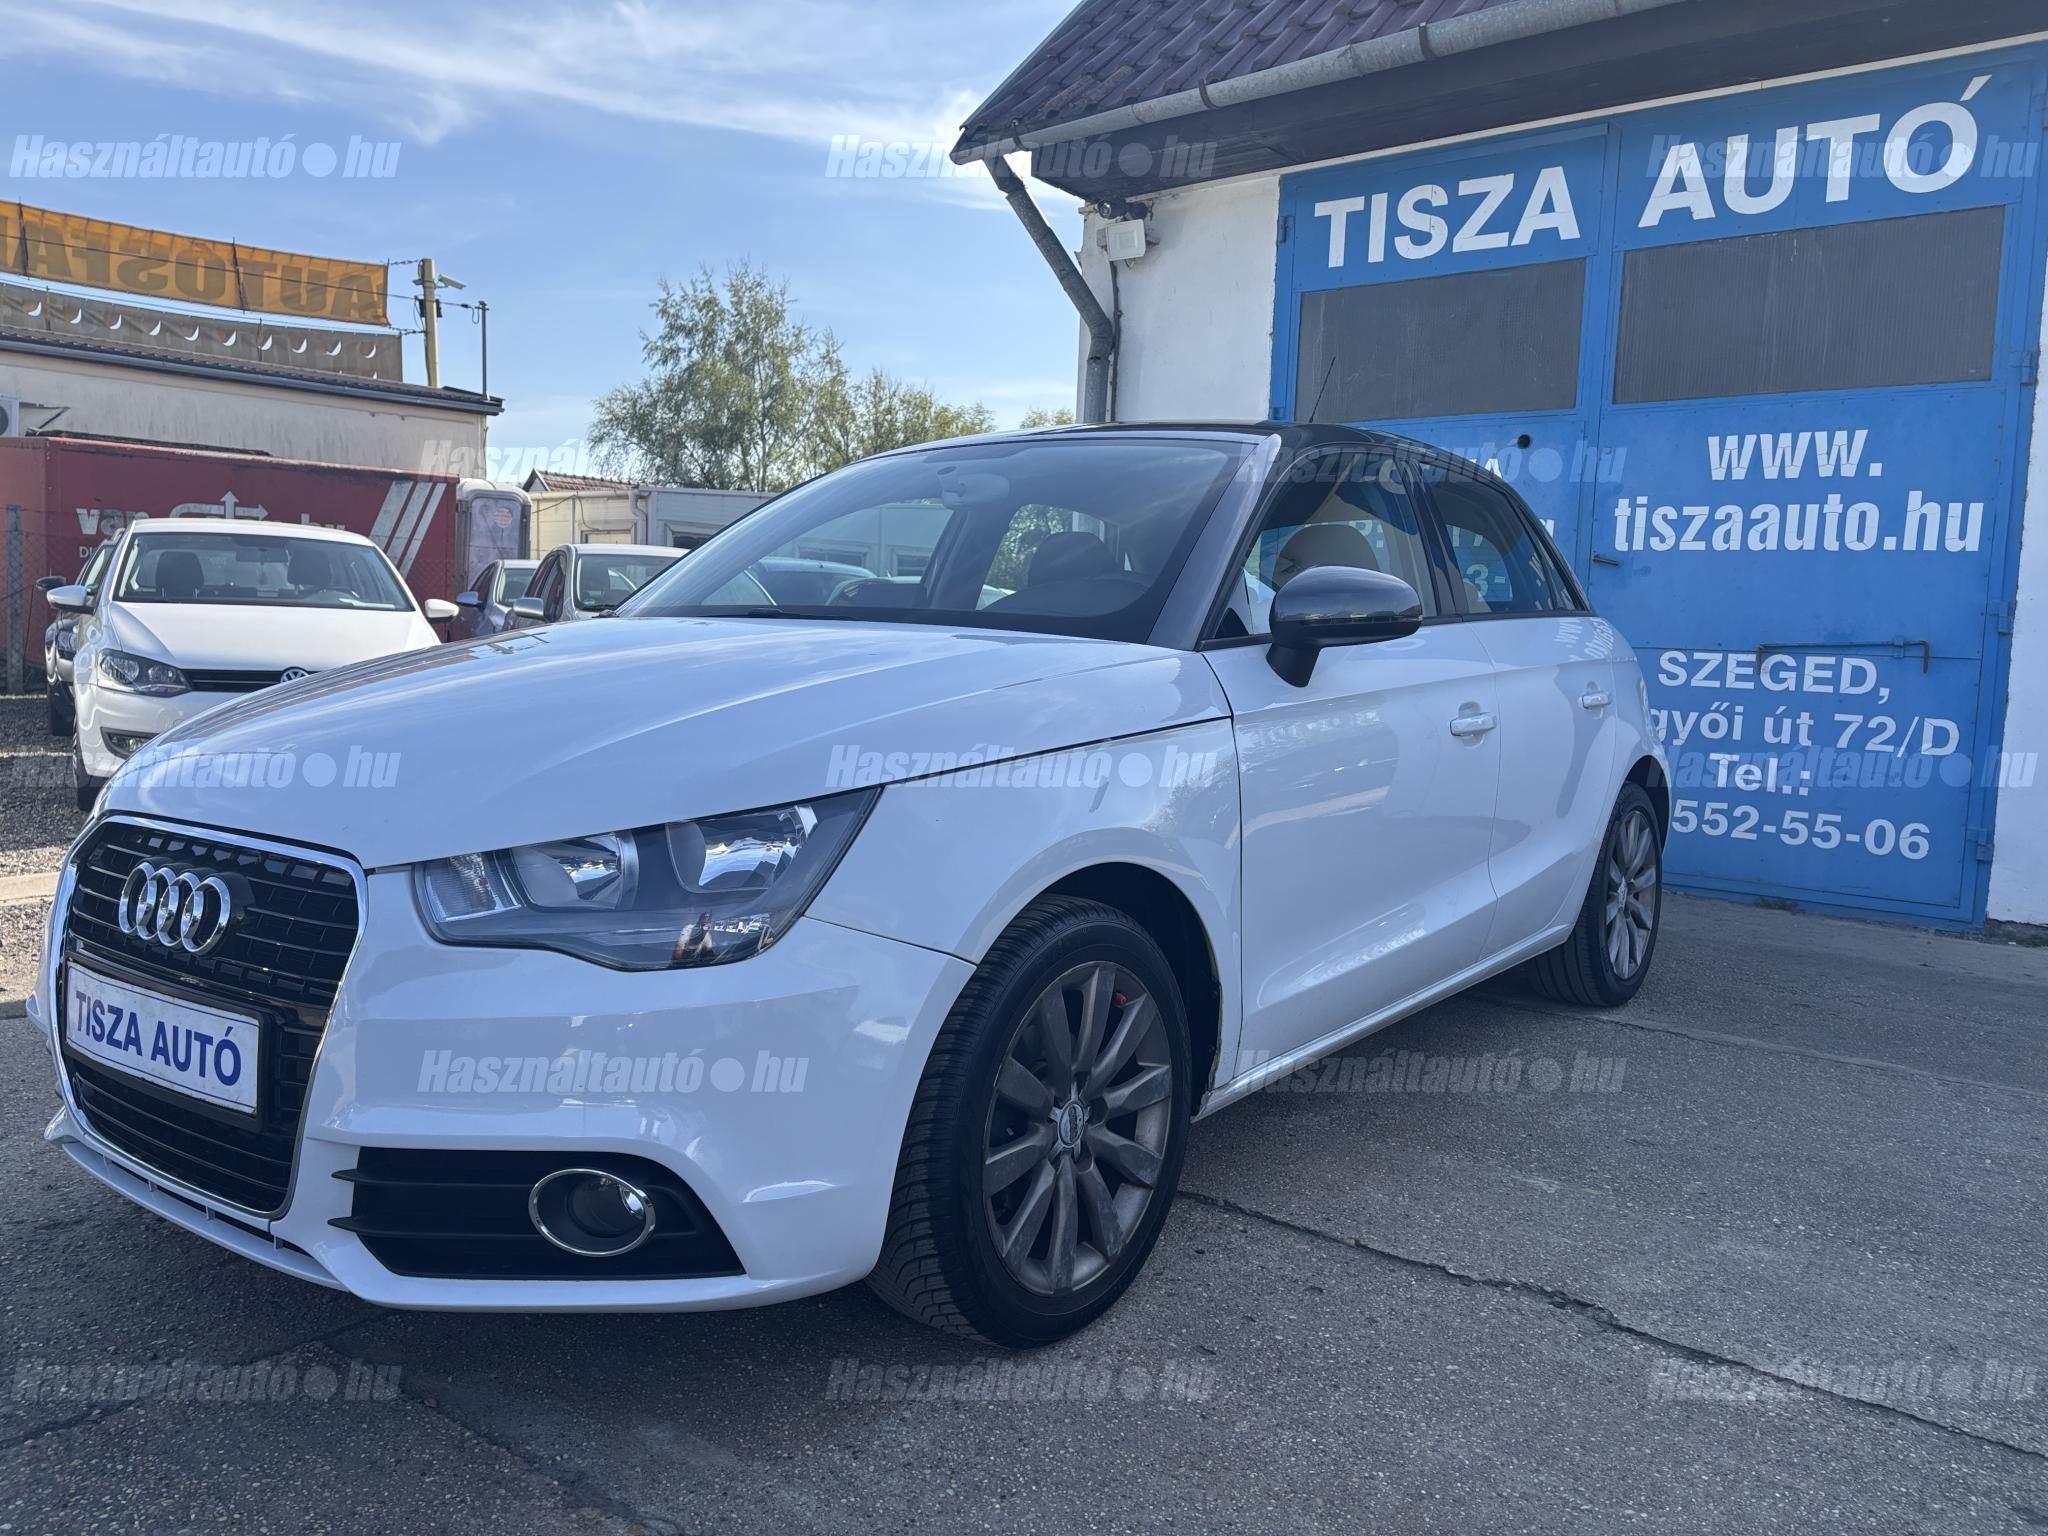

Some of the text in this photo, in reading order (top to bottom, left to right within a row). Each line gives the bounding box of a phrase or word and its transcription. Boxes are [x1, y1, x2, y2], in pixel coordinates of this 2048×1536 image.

[1315, 74, 1993, 268] TISZA AUTÓ
[1614, 490, 1984, 552] tiszaauto.hu
[1658, 650, 1890, 705] SZEGED,
[1763, 705, 1815, 746] út
[1834, 713, 1960, 758] 72/D
[1709, 753, 1811, 796] Tel.:
[1671, 799, 1931, 860] 552-55-06
[76, 990, 241, 1086] TISZA AUTÓ
